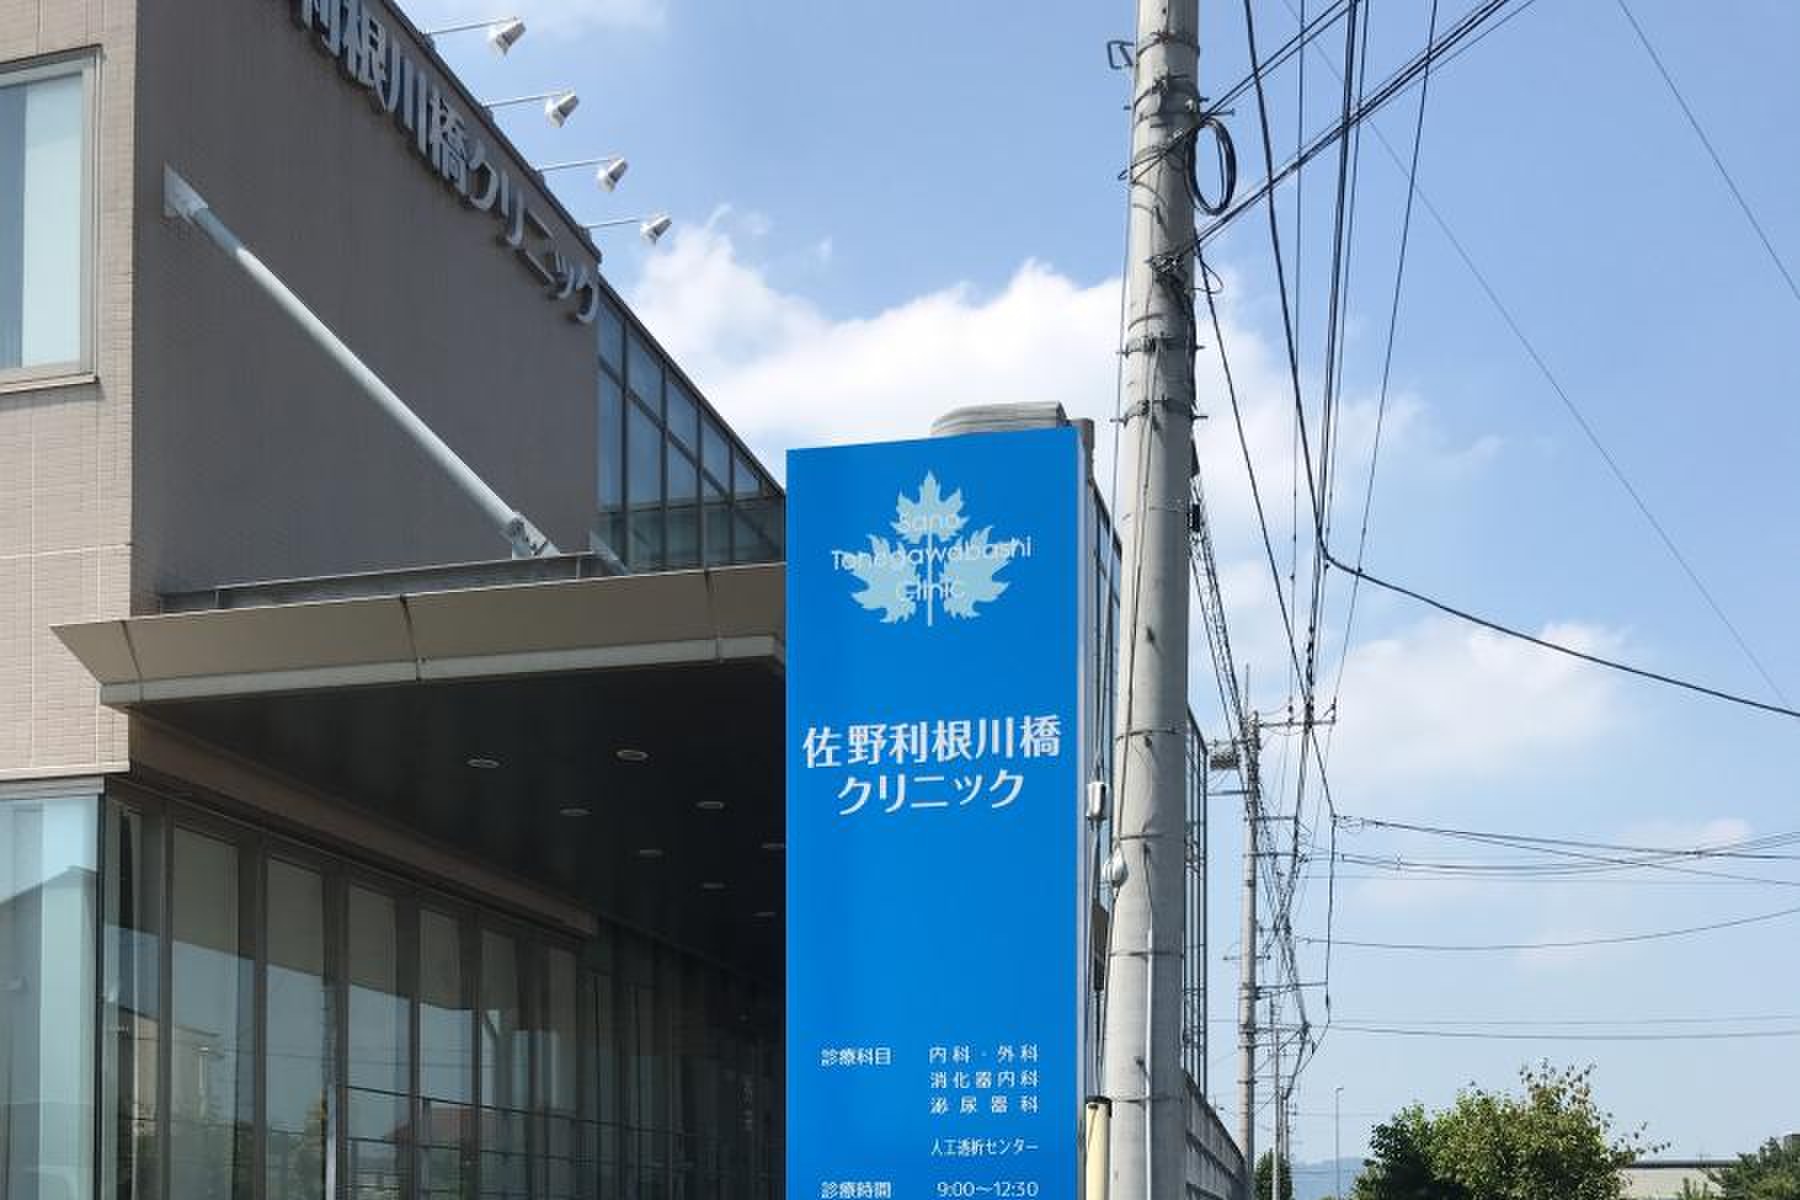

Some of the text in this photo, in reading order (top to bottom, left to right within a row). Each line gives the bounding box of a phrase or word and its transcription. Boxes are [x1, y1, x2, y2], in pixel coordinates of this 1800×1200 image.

[803, 715, 1061, 768] 佐野利根川橋
[838, 769, 1024, 816] クリニック
[821, 1047, 891, 1066] 診療科目
[930, 1070, 1039, 1088] 消化器内科
[930, 1095, 1039, 1114] 泌尿器科
[930, 1138, 1039, 1156] 人工透析センター
[821, 1181, 891, 1199] 診療時間
